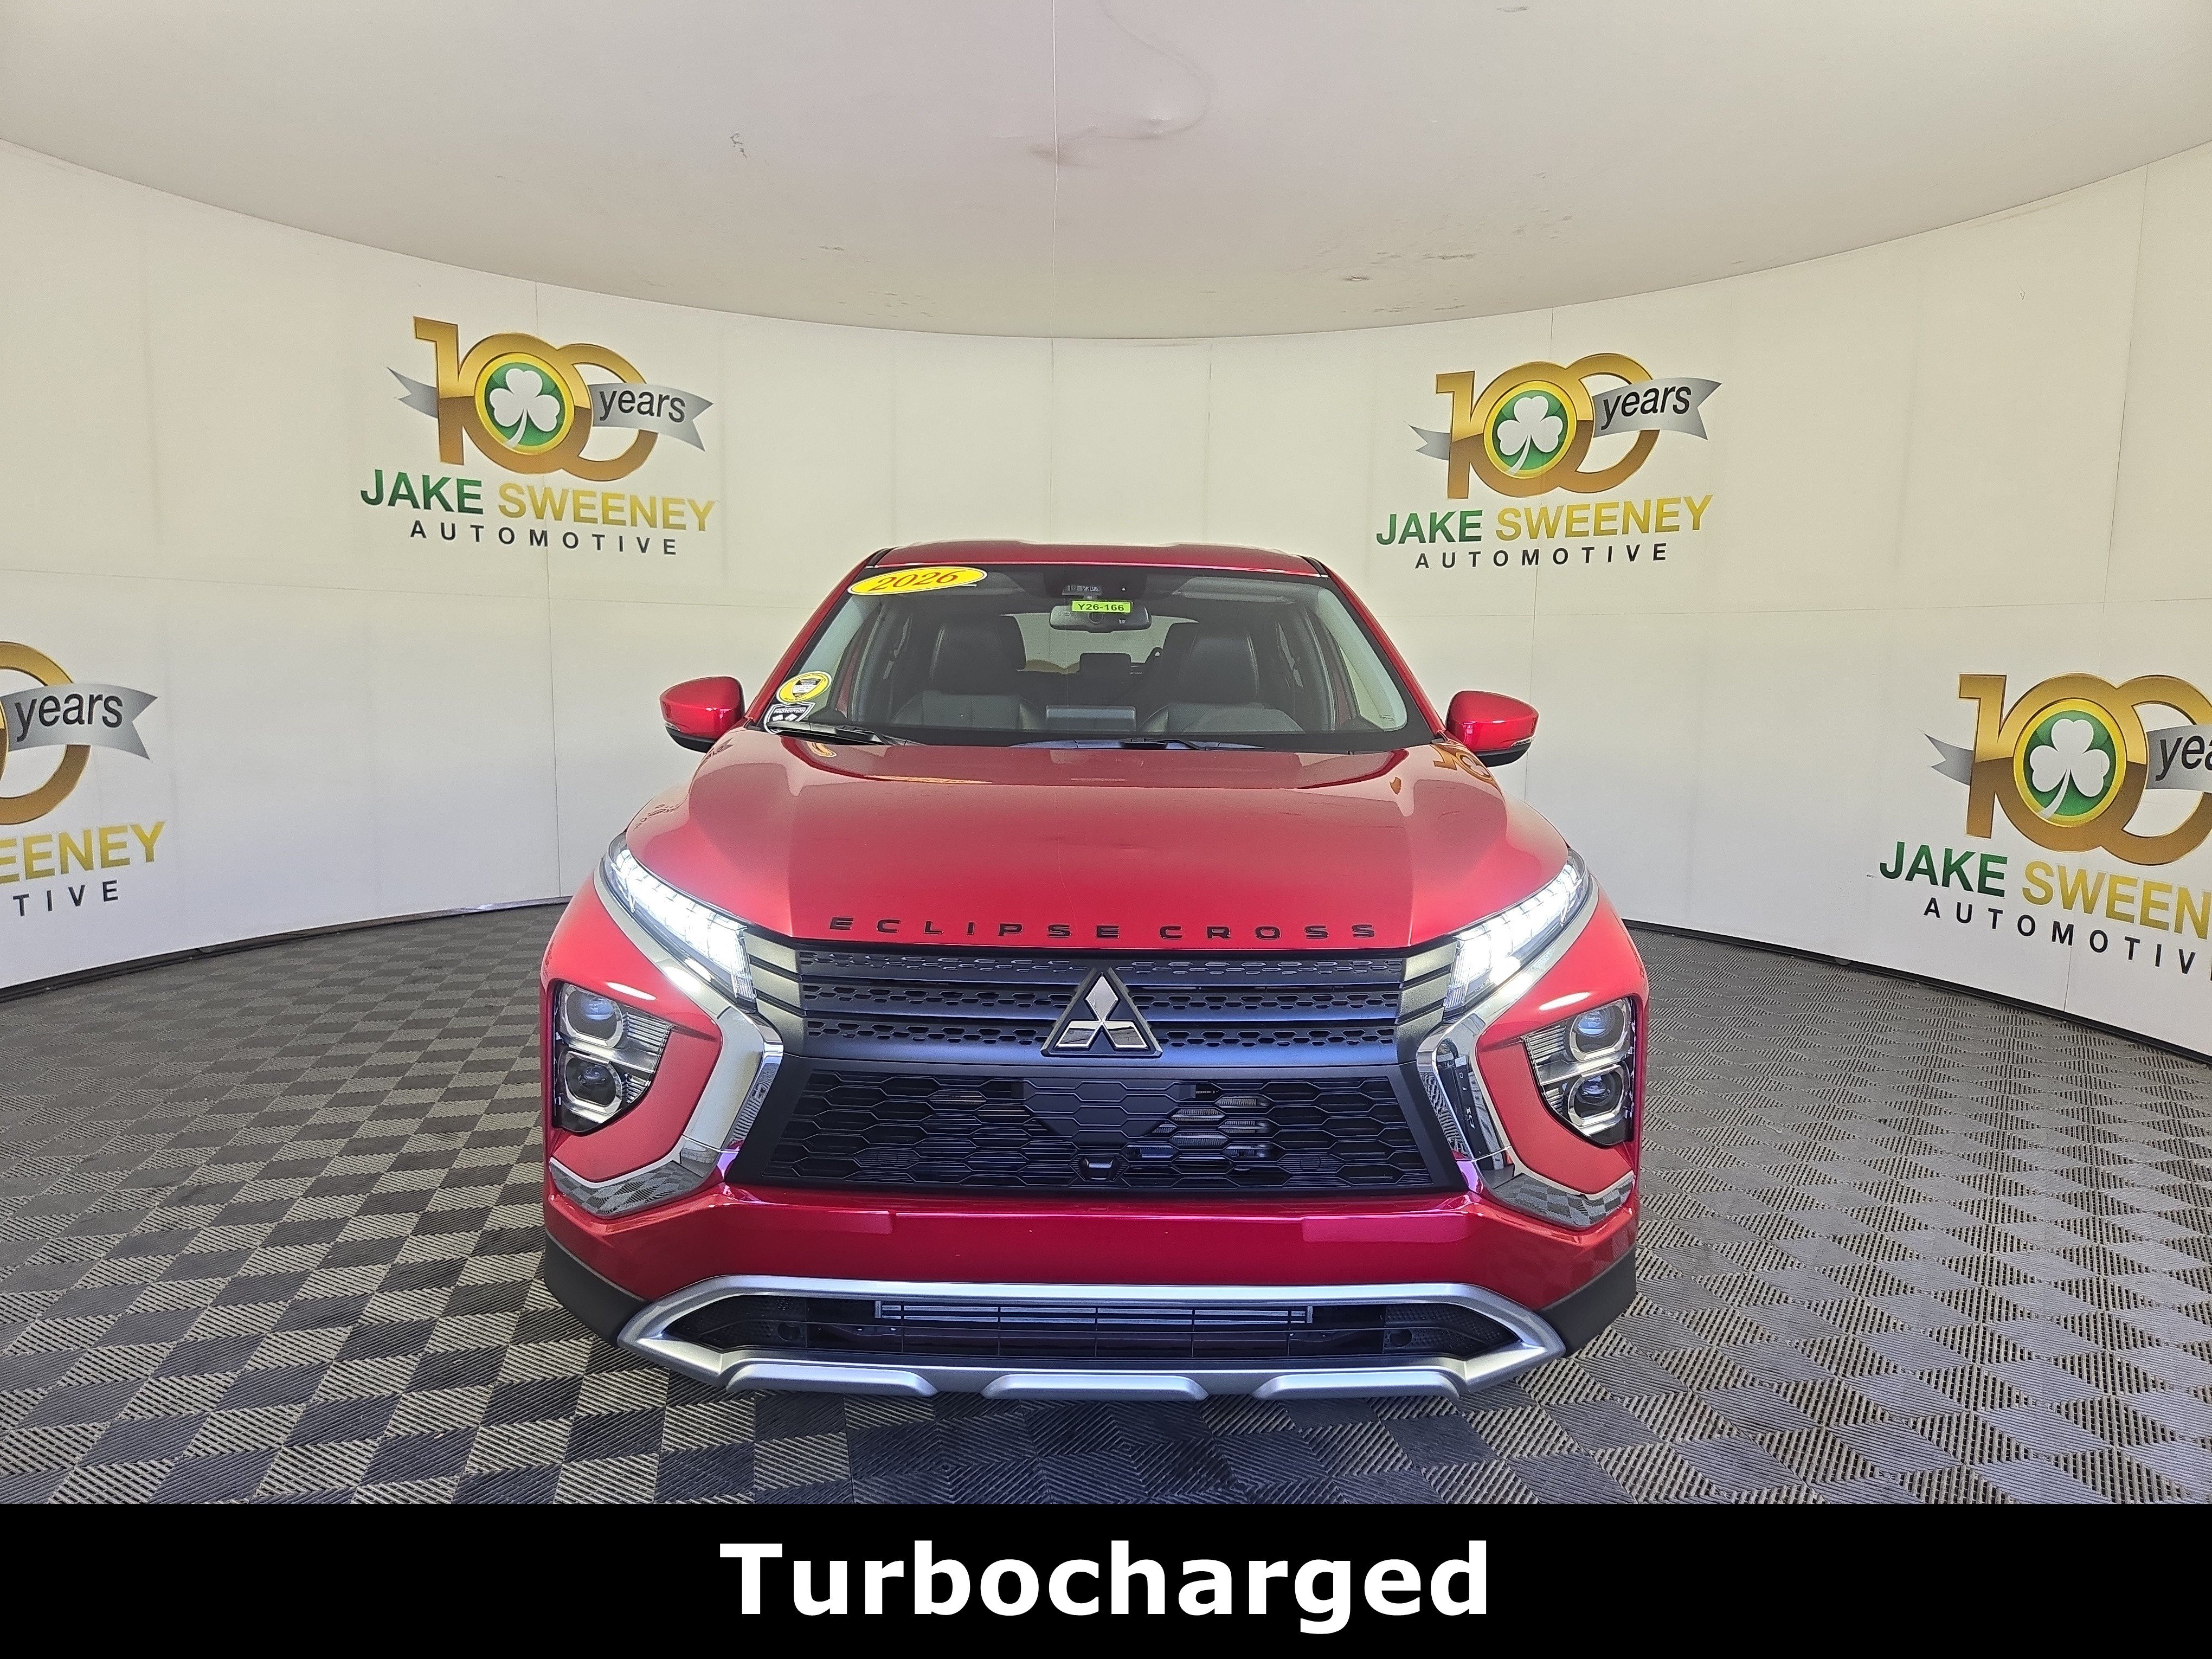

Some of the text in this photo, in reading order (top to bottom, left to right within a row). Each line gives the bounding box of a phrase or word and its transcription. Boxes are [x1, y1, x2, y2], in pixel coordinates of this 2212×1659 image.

[413, 316, 659, 481] 100
[598, 390, 687, 423] years
[1600, 385, 1692, 430] years
[1435, 352, 1661, 500] 100
[361, 468, 715, 532] JAKE SWEENEY
[1376, 494, 1713, 545] JAKE SWEENEY
[410, 520, 677, 555] AUTOMOTIVE
[1415, 543, 1667, 569] AUTOMOTIVE
[867, 570, 966, 591] 2026
[1077, 603, 1124, 612] Y26-166
[15, 693, 124, 743] years
[1879, 841, 2008, 898] JAKE
[829, 916, 1375, 941] ECLIPSE CROSS
[1923, 897, 2212, 982] AUTOMOTIV
